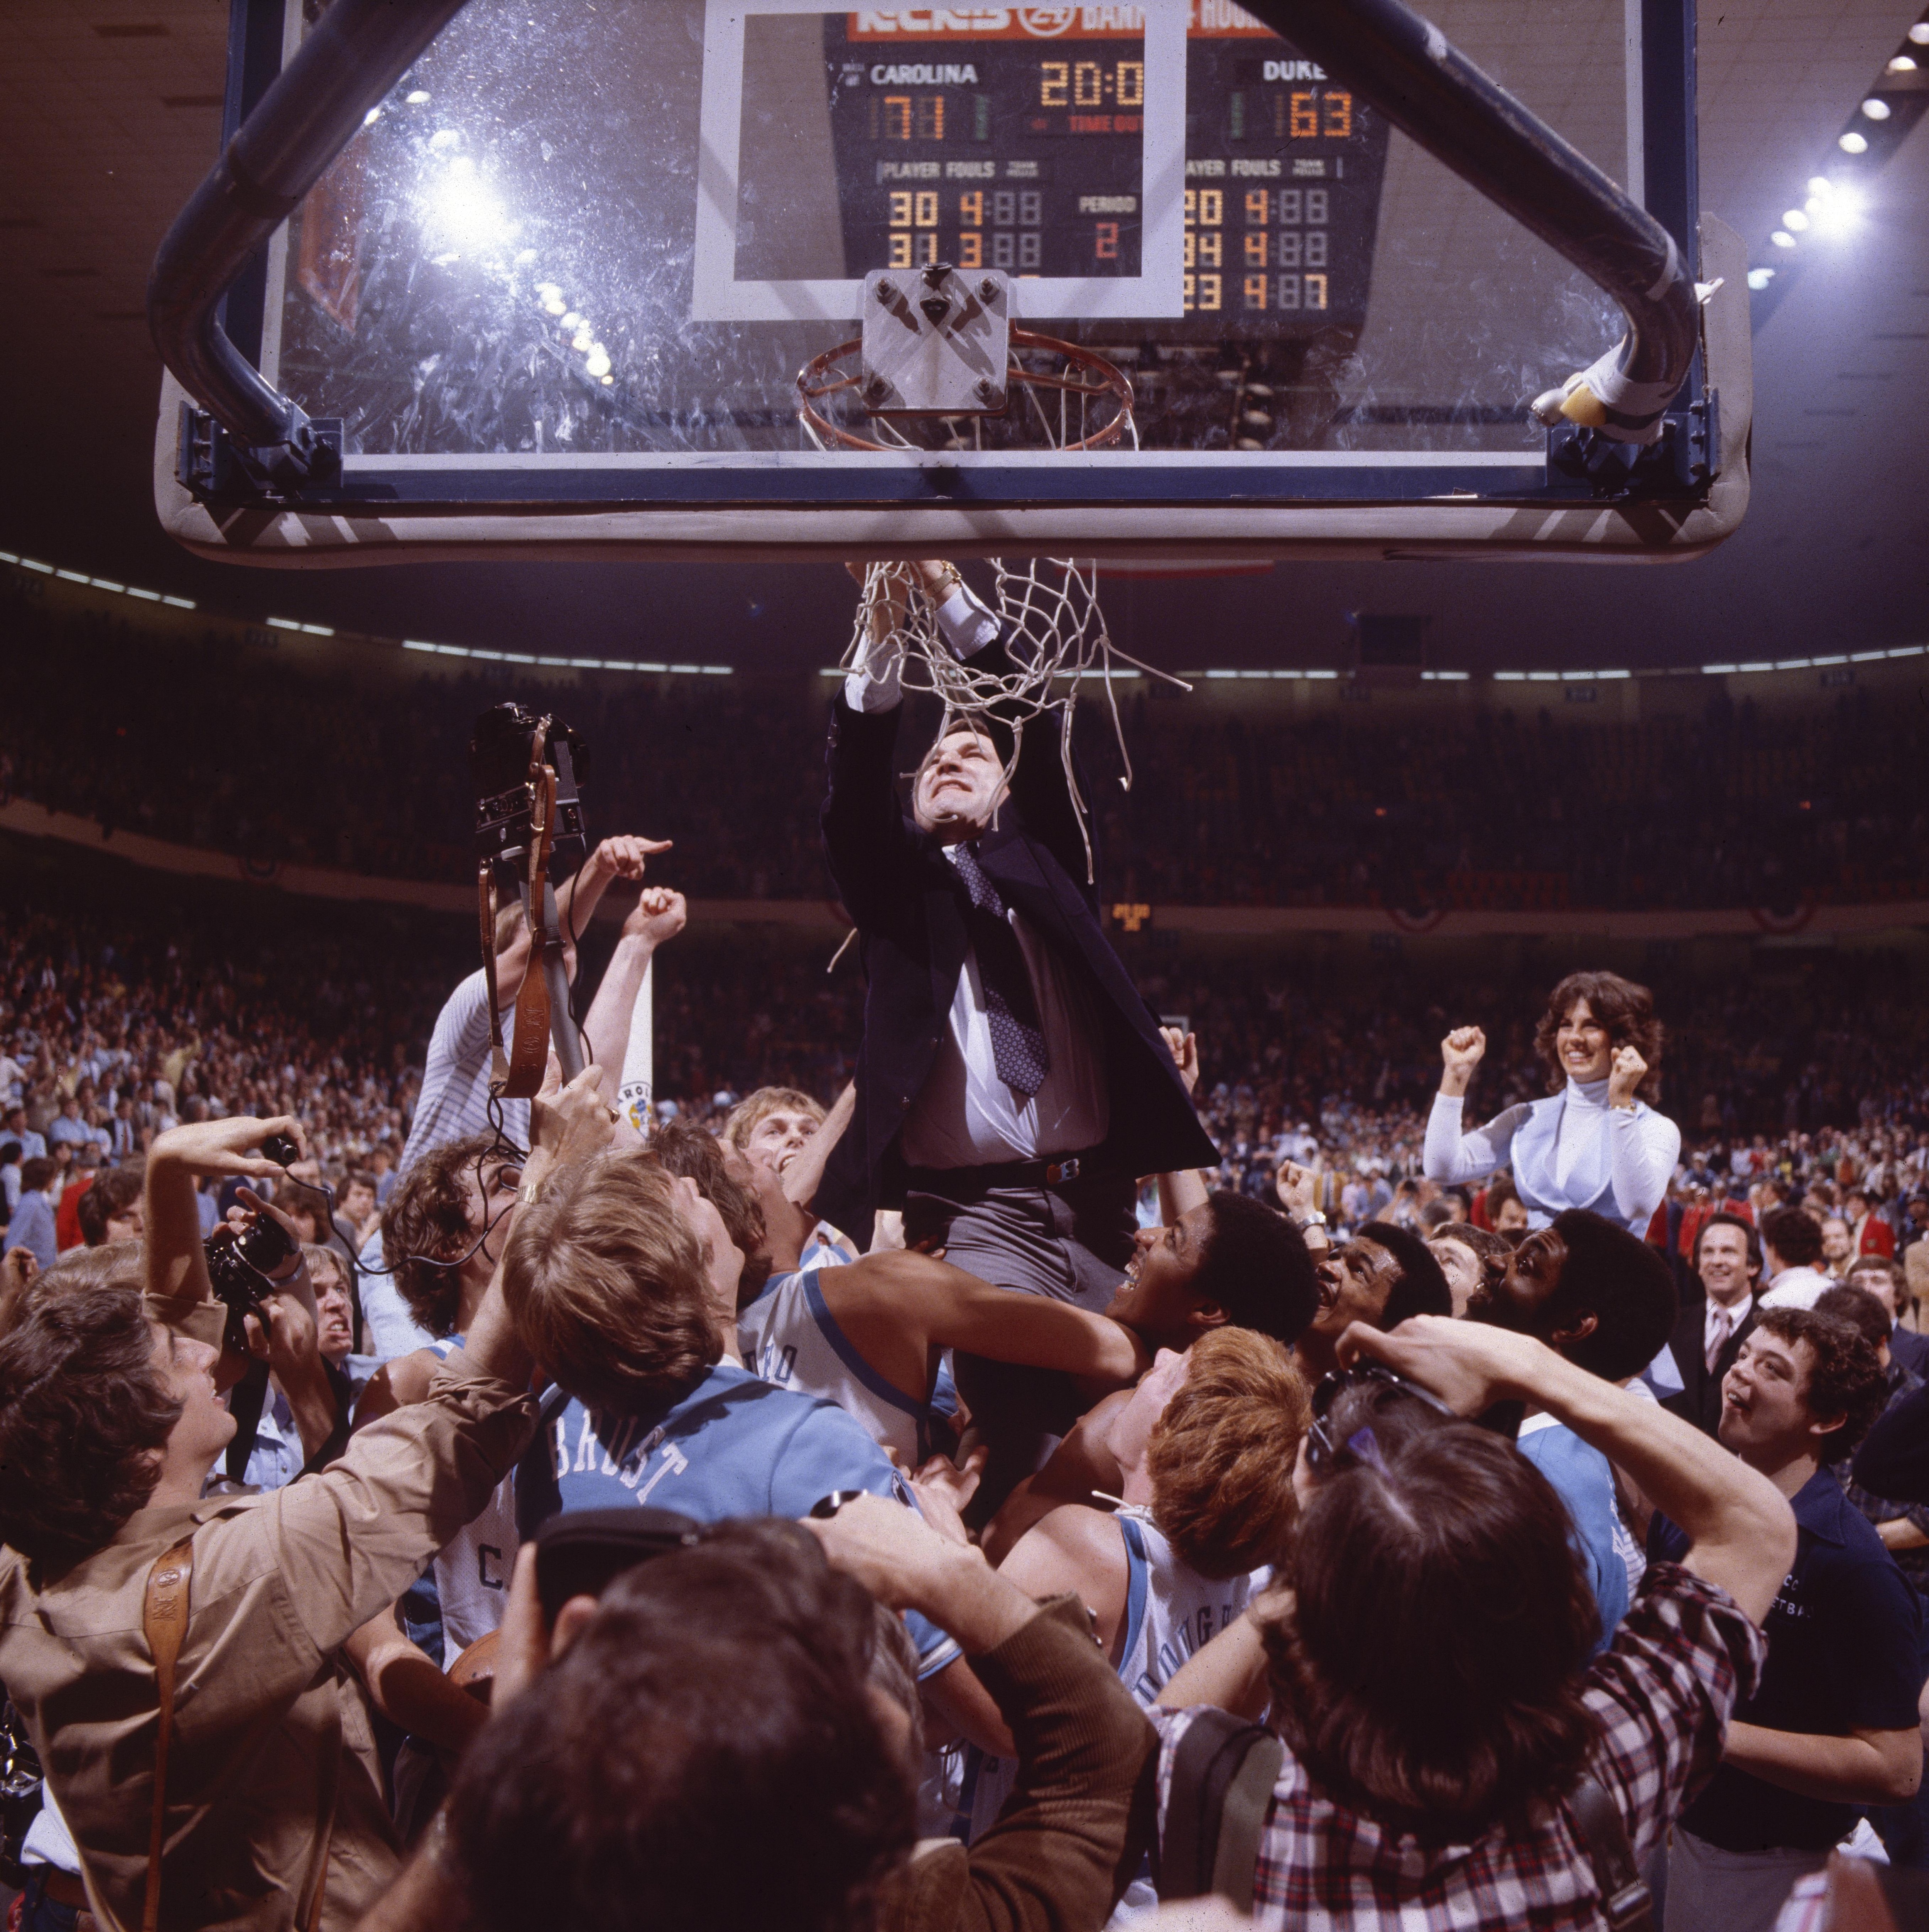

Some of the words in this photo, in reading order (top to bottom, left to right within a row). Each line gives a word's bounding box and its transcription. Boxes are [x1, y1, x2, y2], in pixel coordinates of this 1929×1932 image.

[870, 64, 978, 84] CAROLINA
[1041, 62, 1144, 106] 20:0
[1263, 60, 1328, 81] DUKE
[1114, 115, 1144, 132] OU
[1290, 92, 1351, 137] 63
[883, 162, 940, 178] PLAYER
[946, 161, 995, 178] FOULS
[1185, 159, 1226, 176] AYER
[1231, 159, 1281, 177] FOULS
[889, 191, 938, 226] 30
[960, 191, 983, 226] 4
[1245, 190, 1268, 225] 4
[959, 233, 982, 268] 3
[1095, 222, 1118, 258] 2
[1245, 232, 1267, 267] 4
[1244, 274, 1267, 309] 4
[546, 1408, 689, 1506] BRUST
